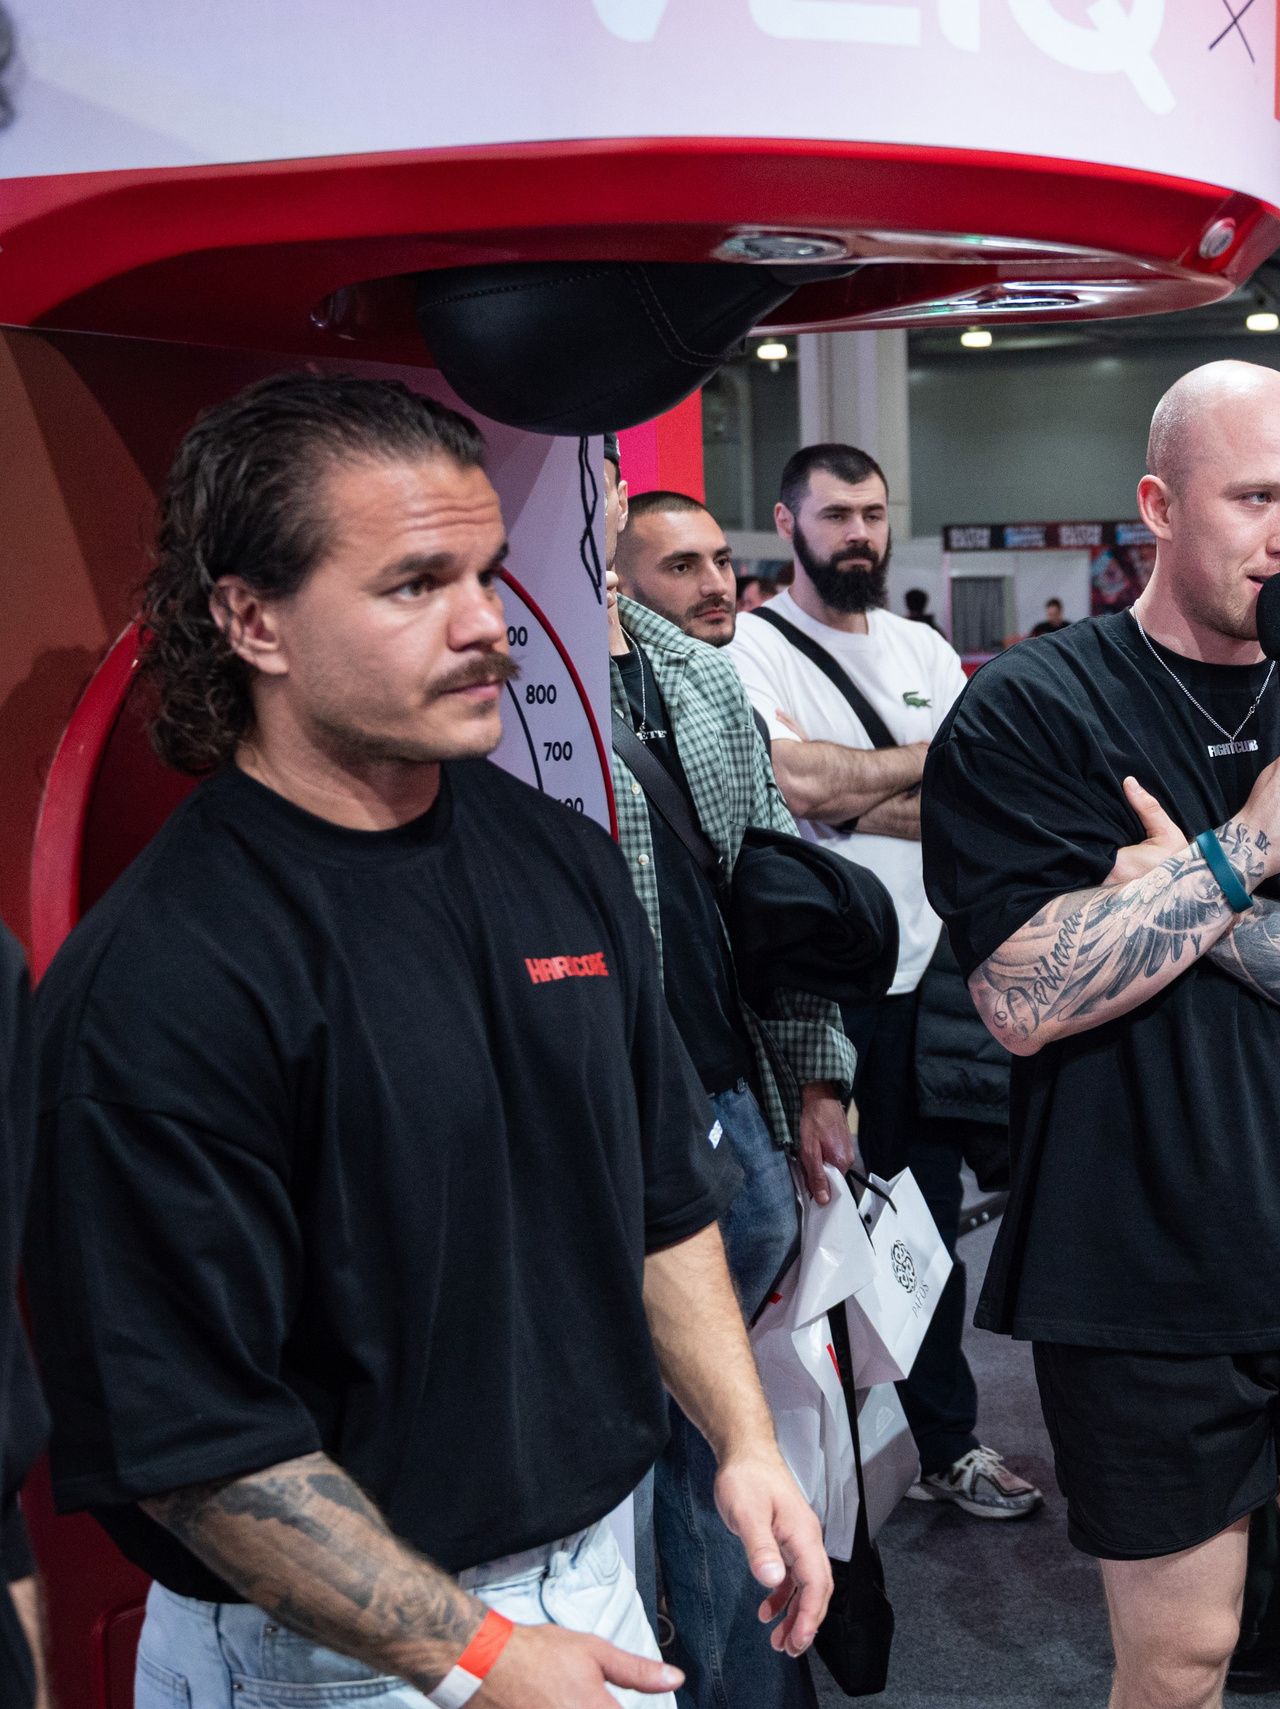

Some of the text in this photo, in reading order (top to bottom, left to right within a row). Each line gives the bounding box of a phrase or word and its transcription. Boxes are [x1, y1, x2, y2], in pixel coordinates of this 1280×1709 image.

[507, 626, 528, 647] 00
[525, 684, 557, 704] 800
[543, 741, 573, 761] 700
[911, 1280, 930, 1319] PAFOS
